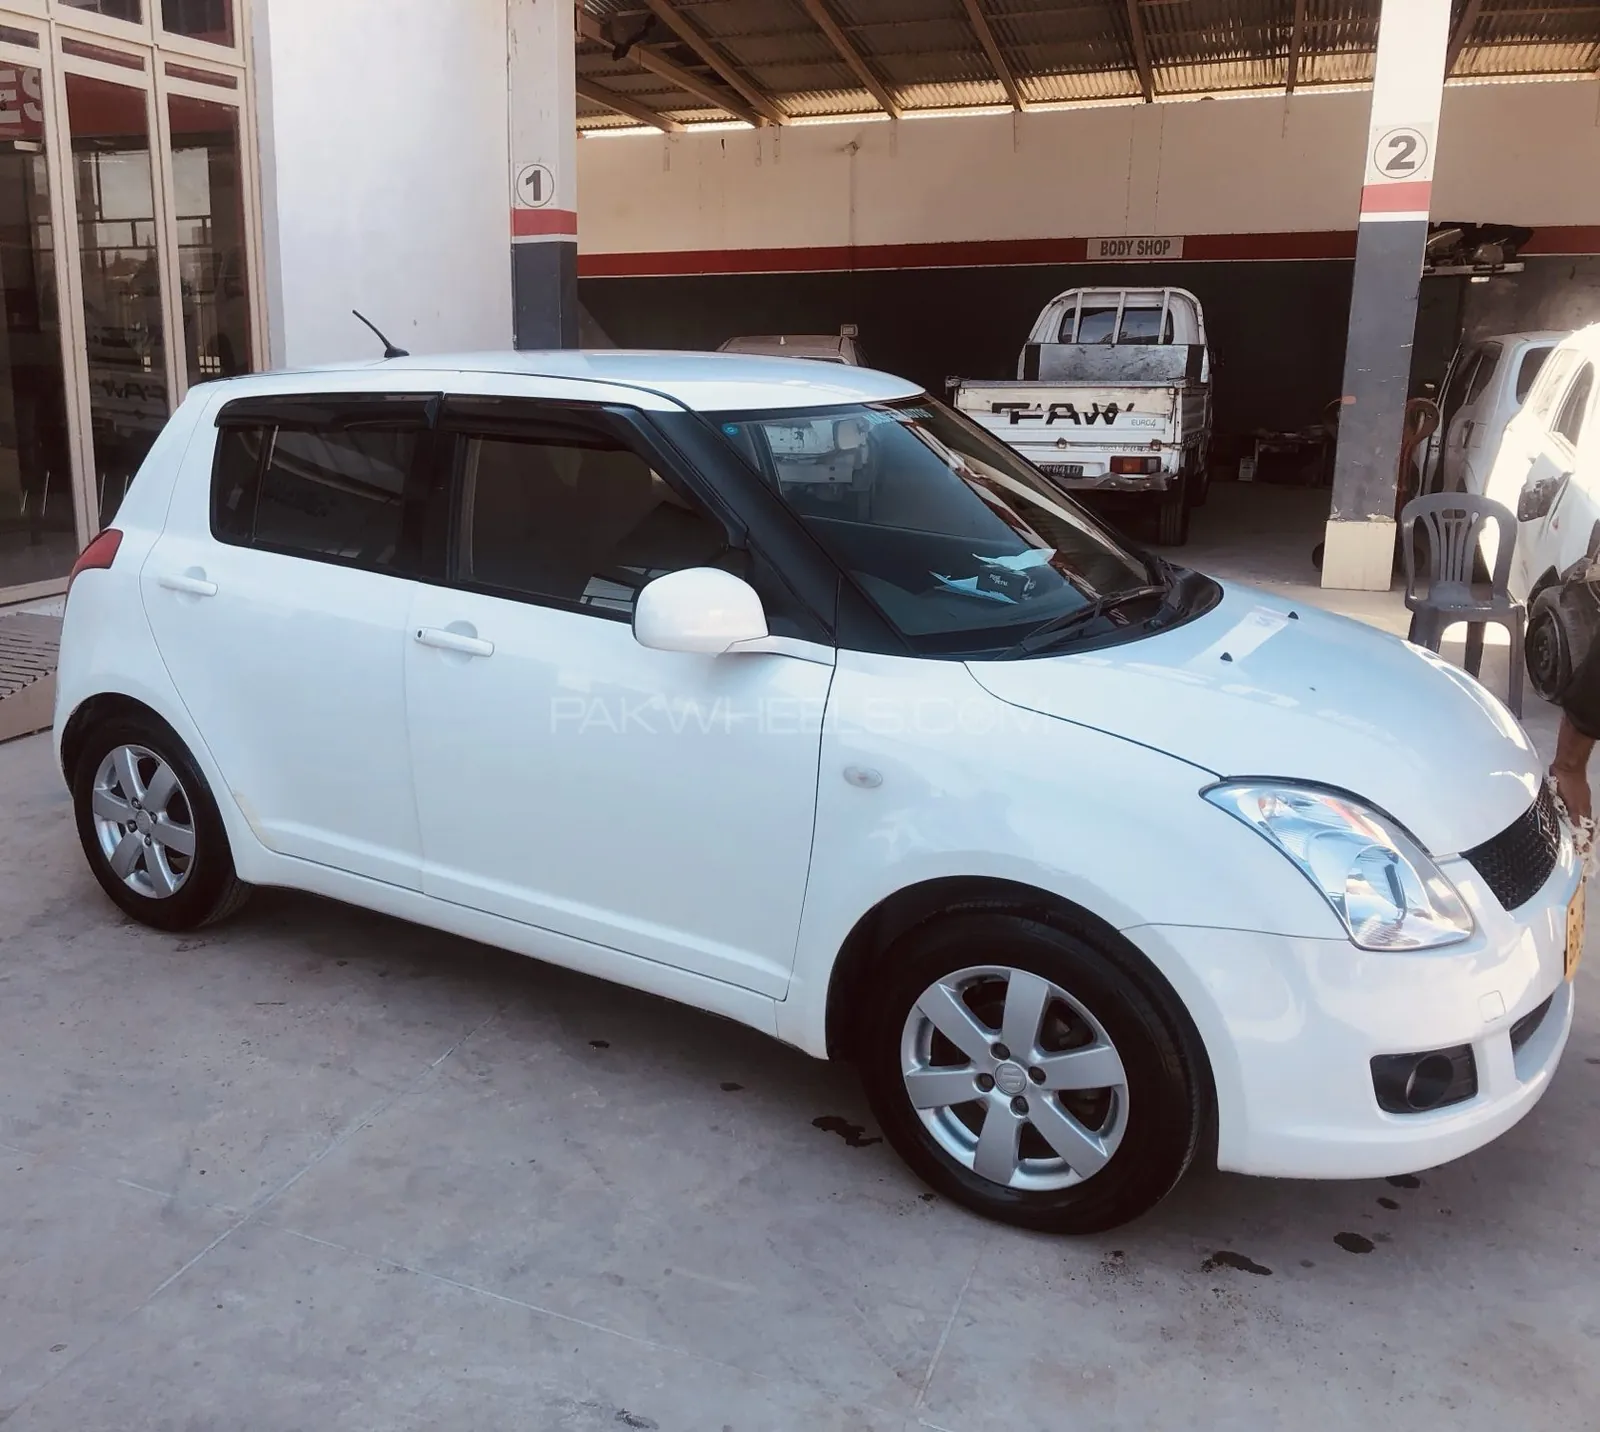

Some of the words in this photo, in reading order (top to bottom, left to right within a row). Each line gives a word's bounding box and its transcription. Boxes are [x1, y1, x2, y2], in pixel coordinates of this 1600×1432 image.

[1385, 135, 1417, 170] 2
[525, 169, 542, 201] 1
[1100, 240, 1134, 256] BODY
[1136, 239, 1171, 255] SHOP
[991, 402, 1135, 425] FAW
